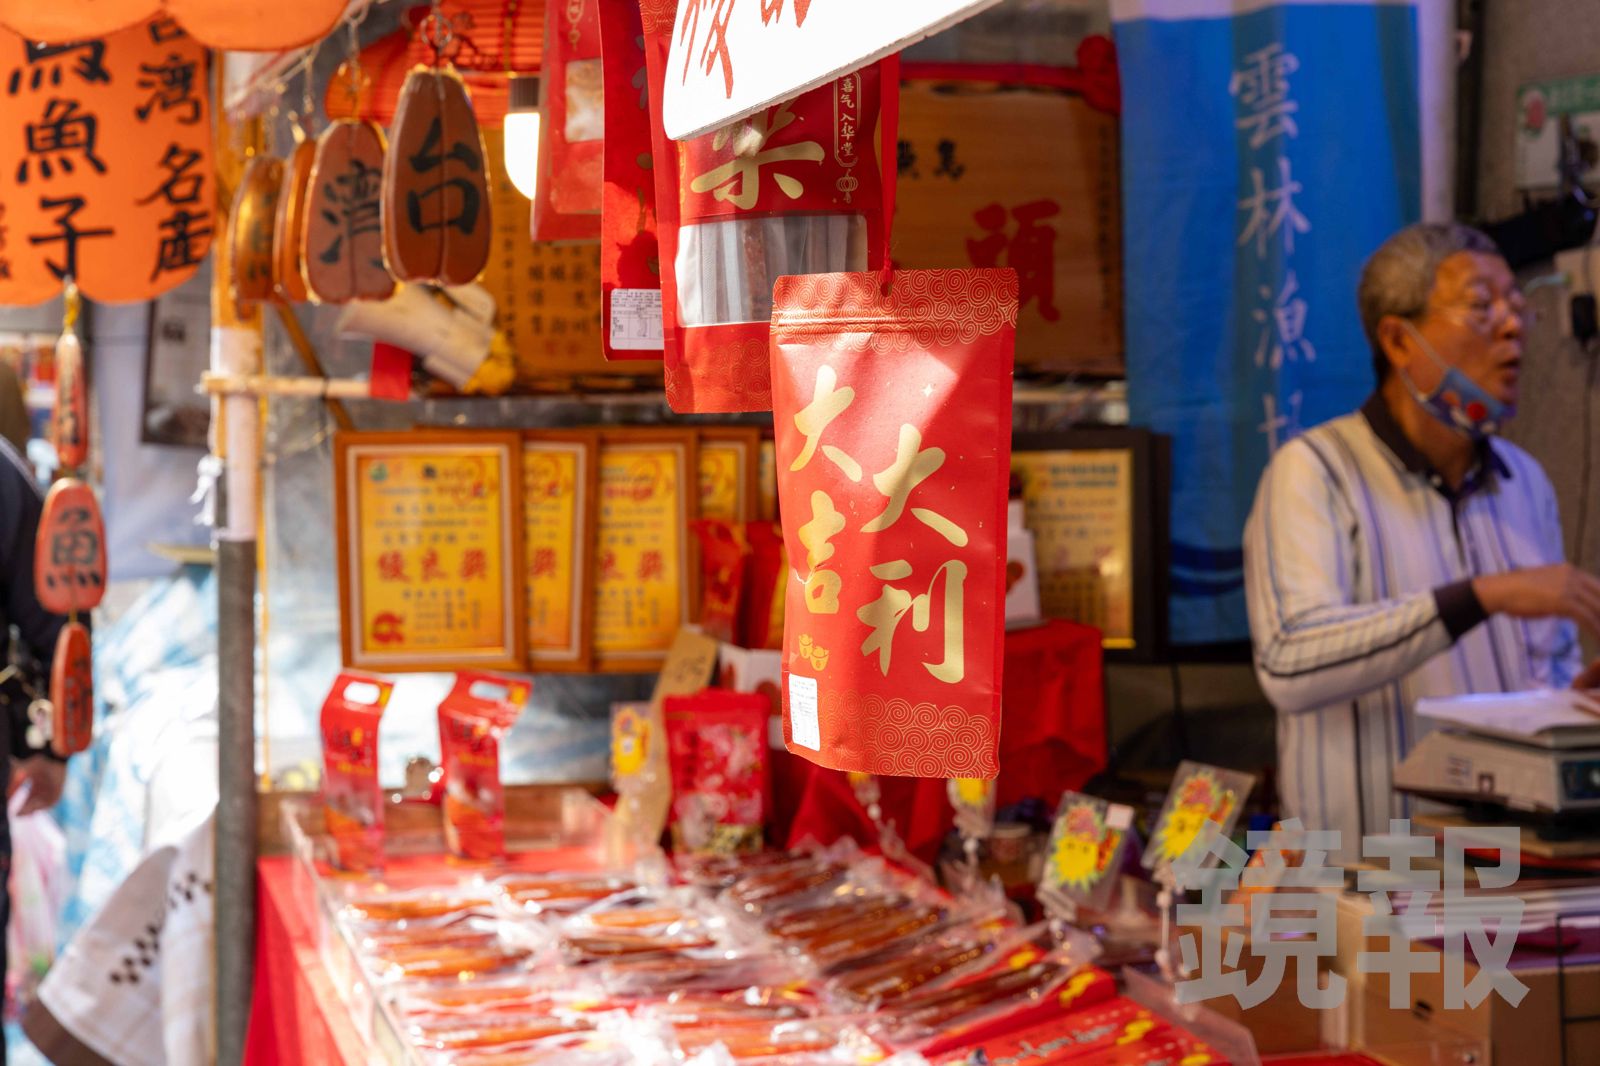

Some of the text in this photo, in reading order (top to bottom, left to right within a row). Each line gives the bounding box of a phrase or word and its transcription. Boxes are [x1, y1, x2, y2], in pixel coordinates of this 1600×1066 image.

[407, 116, 481, 236] 台
[789, 364, 863, 614] 大吉
[857, 422, 970, 684] 大利
